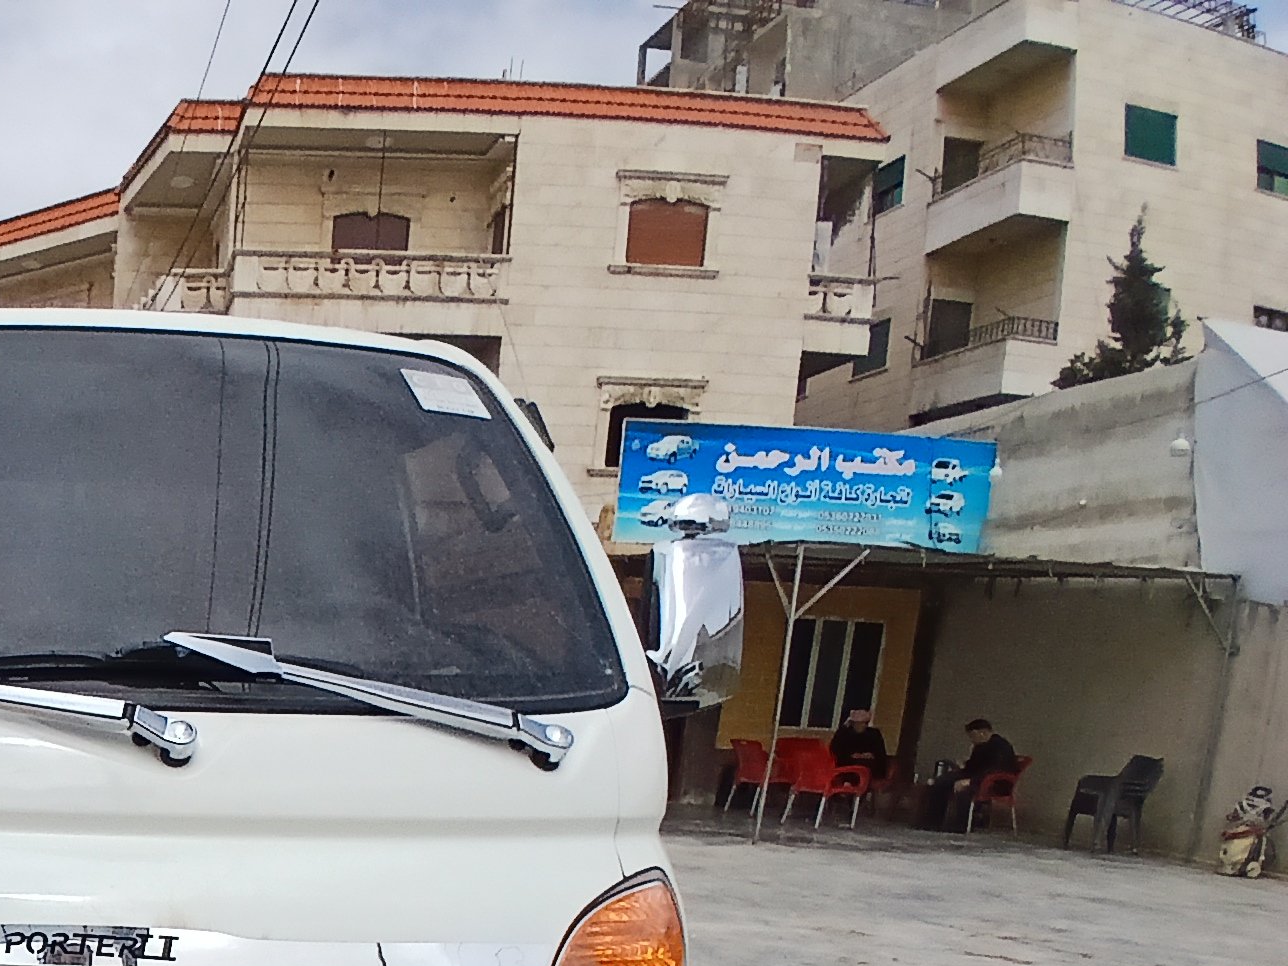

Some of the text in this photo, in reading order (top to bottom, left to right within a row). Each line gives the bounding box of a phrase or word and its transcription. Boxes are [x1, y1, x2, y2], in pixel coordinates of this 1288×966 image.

[716, 442, 916, 480] مكتب الرحمن
[712, 476, 778, 504] السيارات
[820, 480, 863, 504] كافة
[863, 483, 912, 510] لتجارة
[4, 931, 139, 959] PORTER
